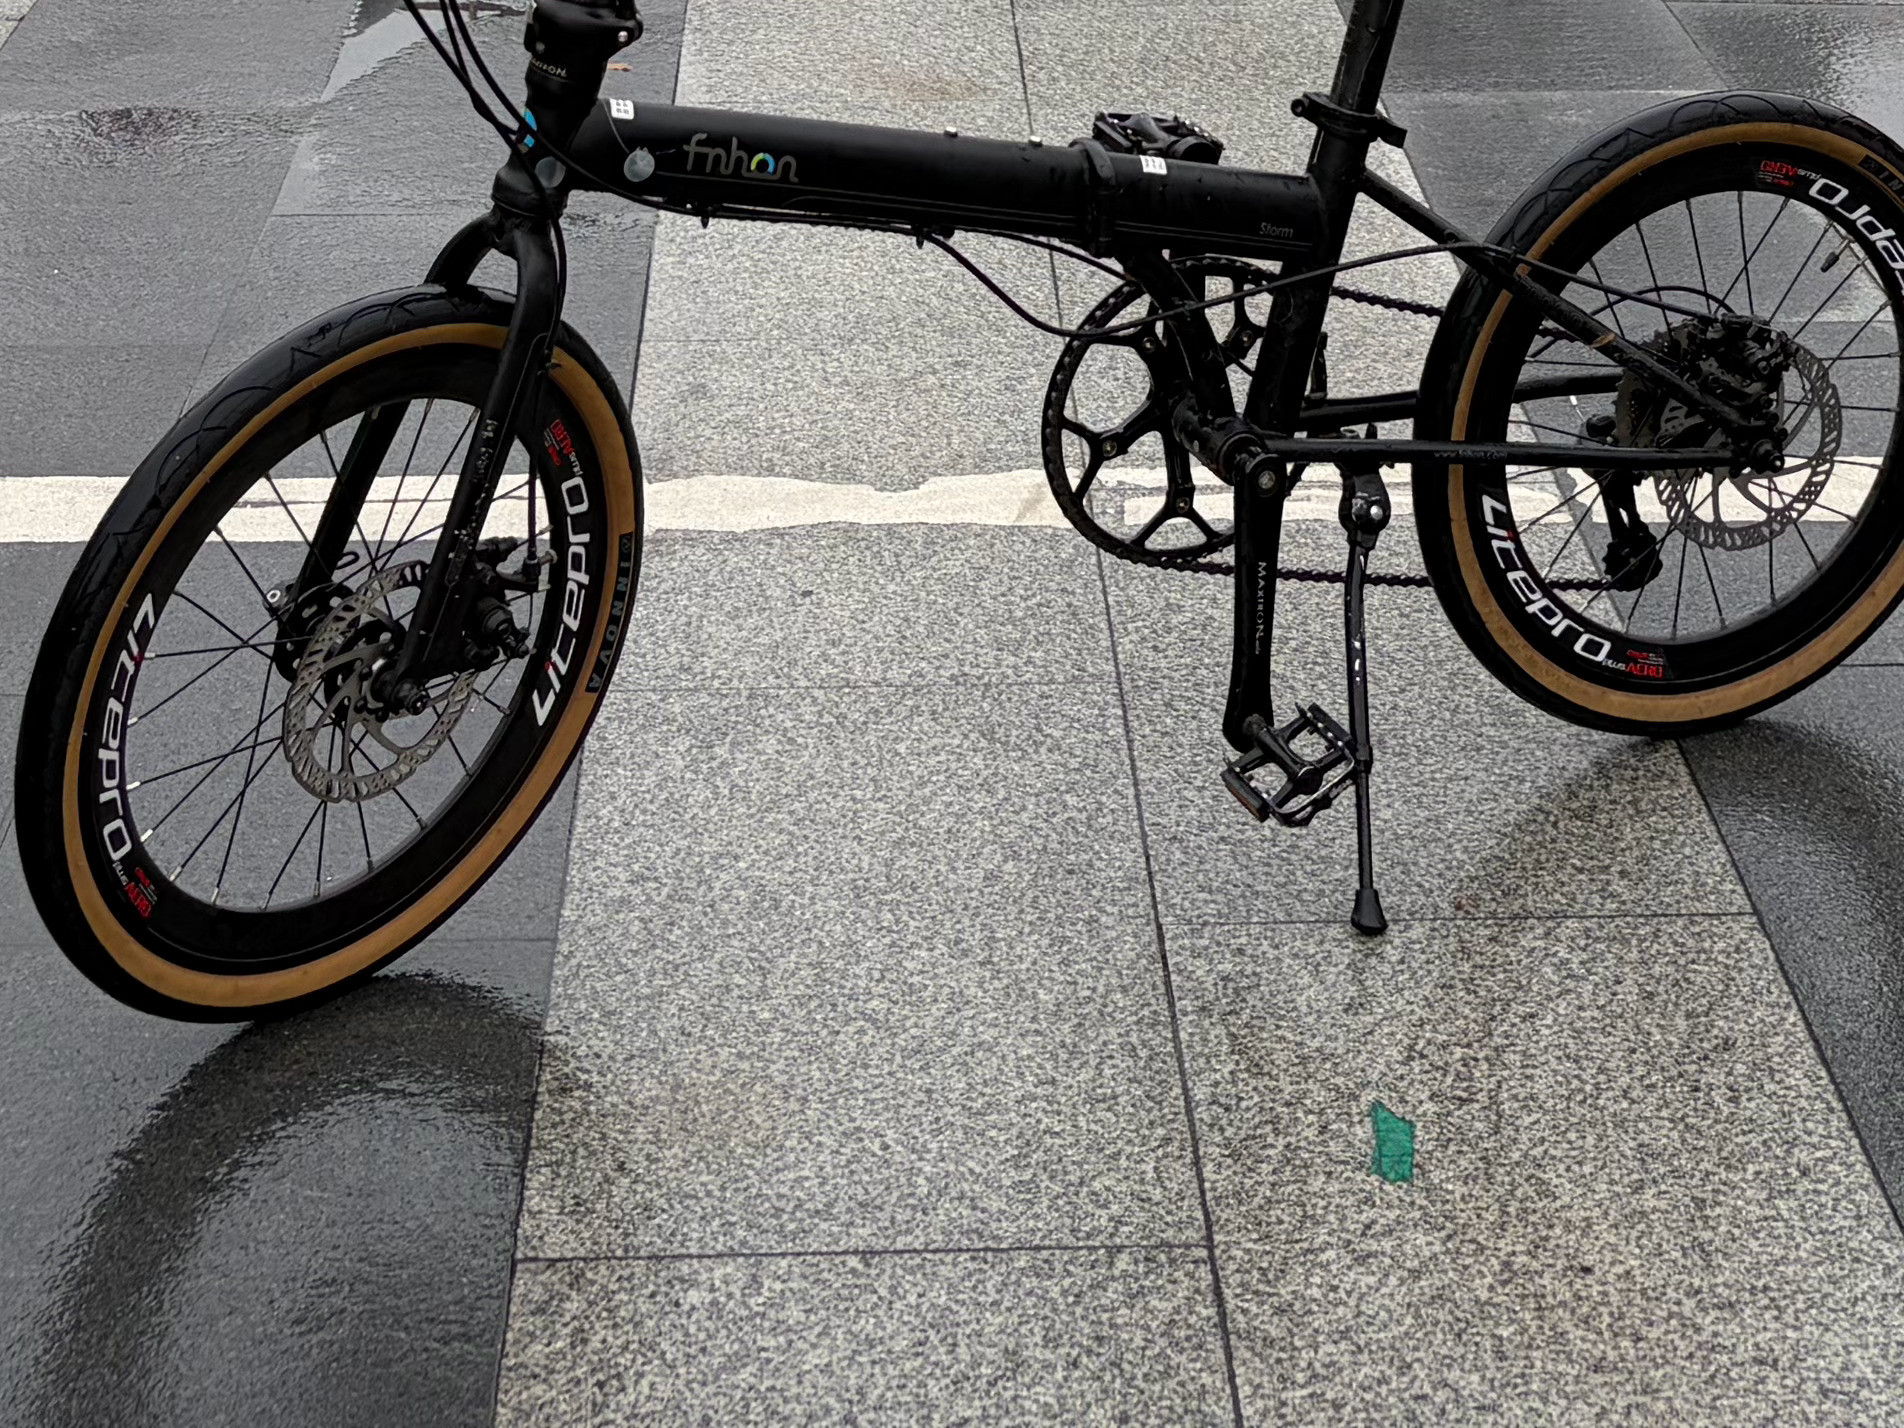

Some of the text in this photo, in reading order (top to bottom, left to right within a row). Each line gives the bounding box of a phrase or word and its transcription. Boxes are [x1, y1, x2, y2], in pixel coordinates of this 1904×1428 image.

[683, 132, 799, 184] fnhon
[1259, 222, 1294, 239] Storm
[588, 560, 632, 690] INNOVA
